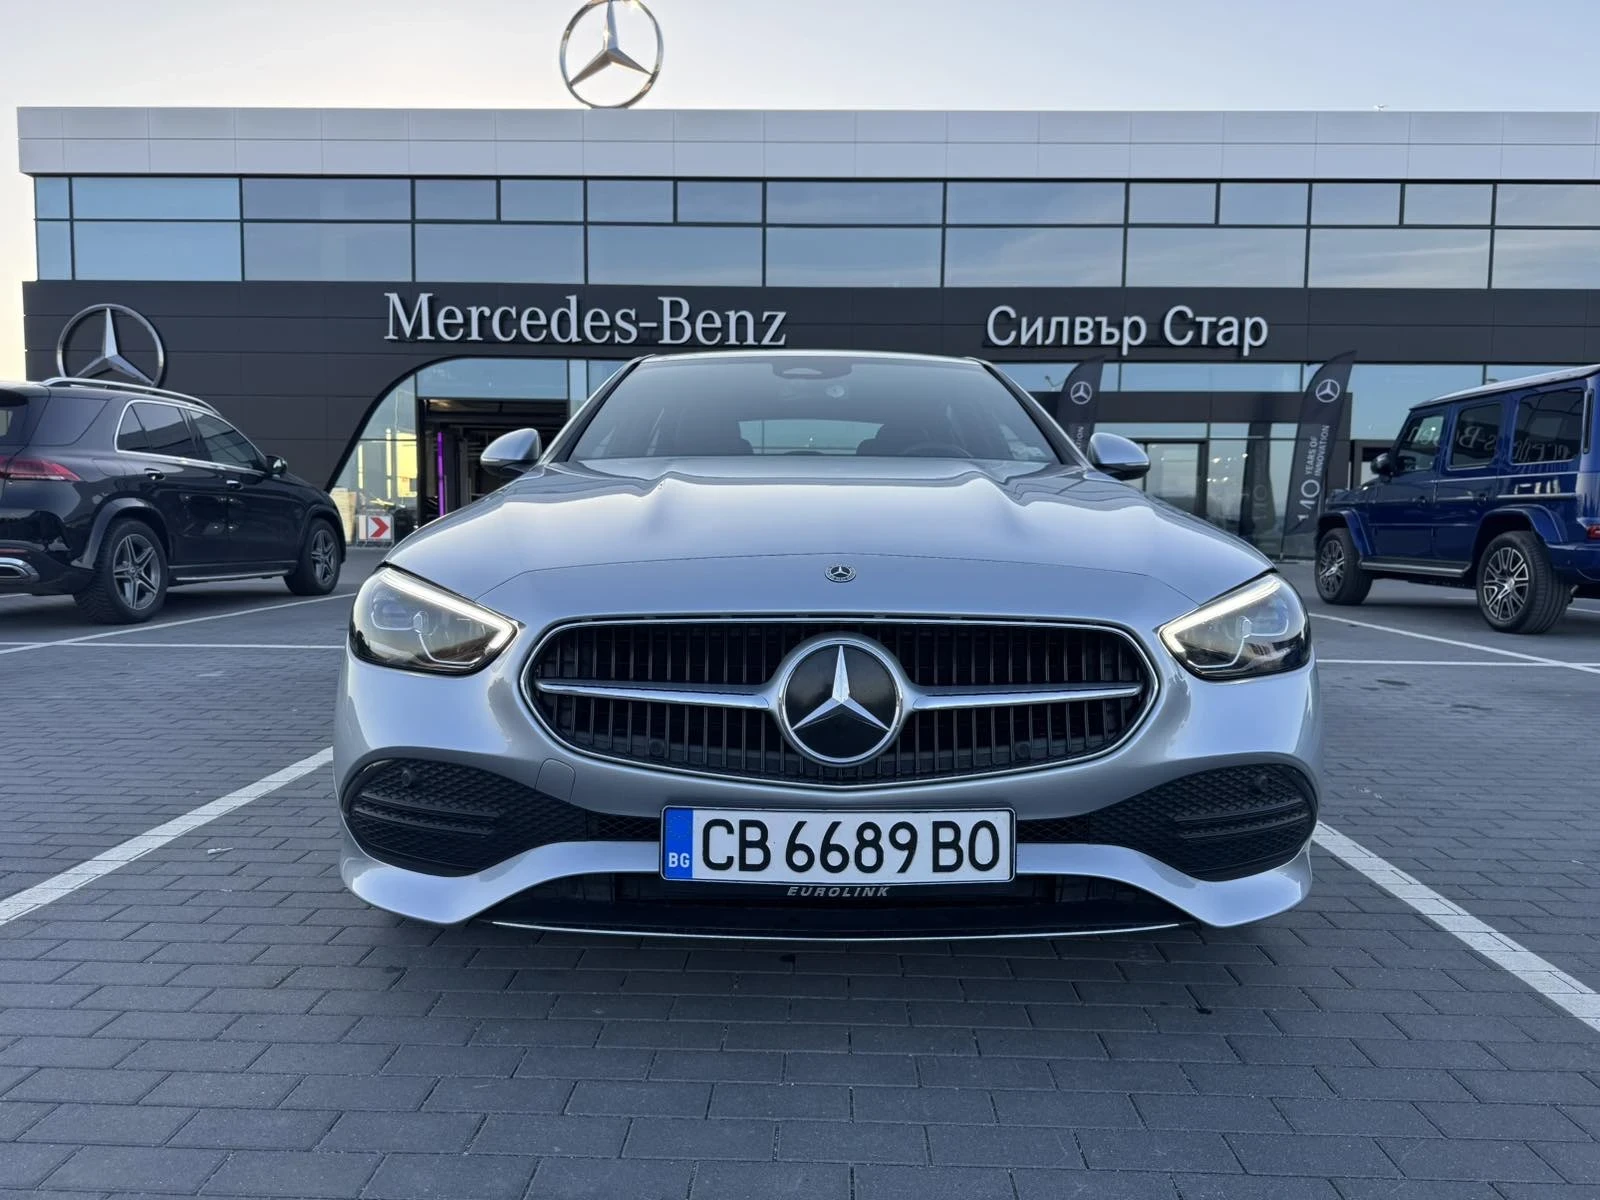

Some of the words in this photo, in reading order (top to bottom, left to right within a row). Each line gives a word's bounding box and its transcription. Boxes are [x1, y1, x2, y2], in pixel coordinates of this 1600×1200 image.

[384, 292, 788, 345] Mercedes-Benz
[986, 305, 1147, 356] Силвър
[1163, 305, 1268, 356] Стар
[1310, 436, 1318, 448] OF
[1314, 425, 1330, 476] INNOVATION
[1305, 449, 1317, 475] YEARS
[668, 852, 690, 868] BG
[702, 818, 771, 872] CB
[785, 820, 918, 873] 6689
[786, 886, 891, 897] EUROLINK
